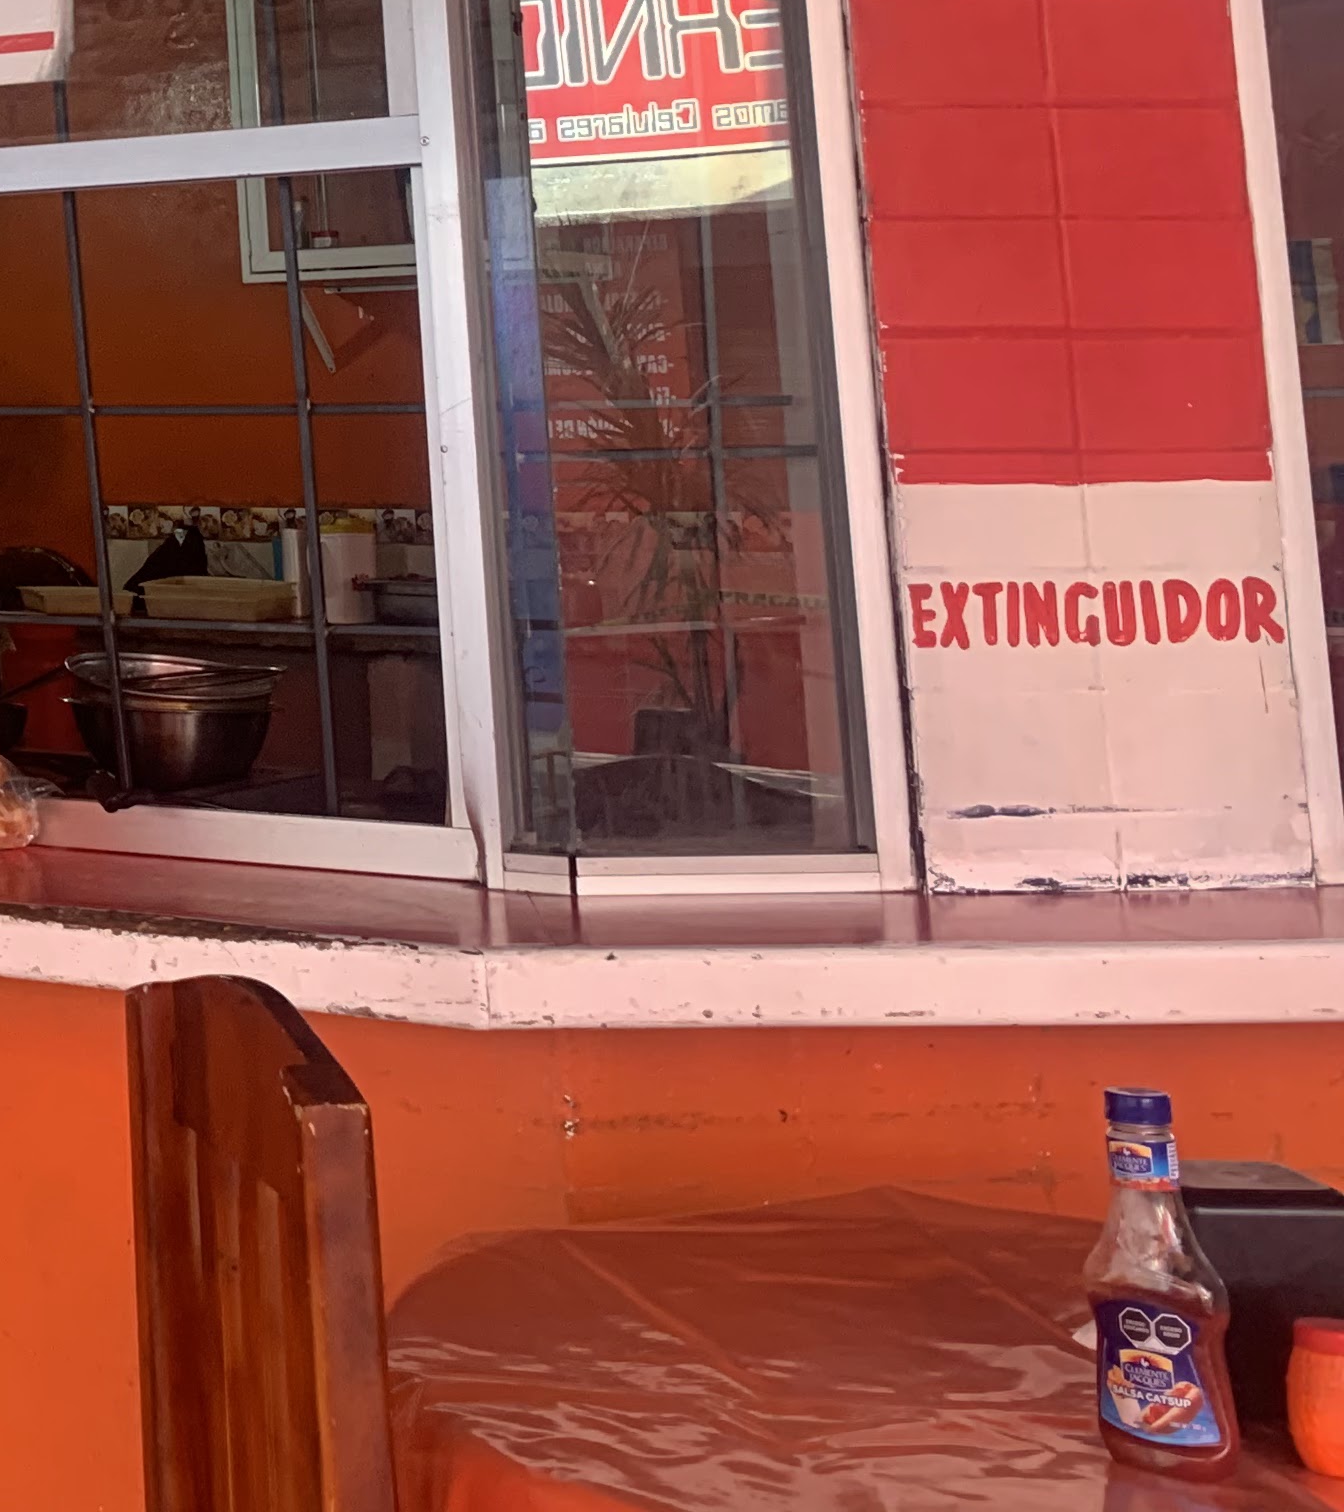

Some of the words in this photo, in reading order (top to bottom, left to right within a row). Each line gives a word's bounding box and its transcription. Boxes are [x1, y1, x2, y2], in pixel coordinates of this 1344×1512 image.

[907, 576, 1286, 650] EXTINGUIDOR
[1112, 1385, 1144, 1400] SALSA
[1145, 1392, 1191, 1408] CATSUP
